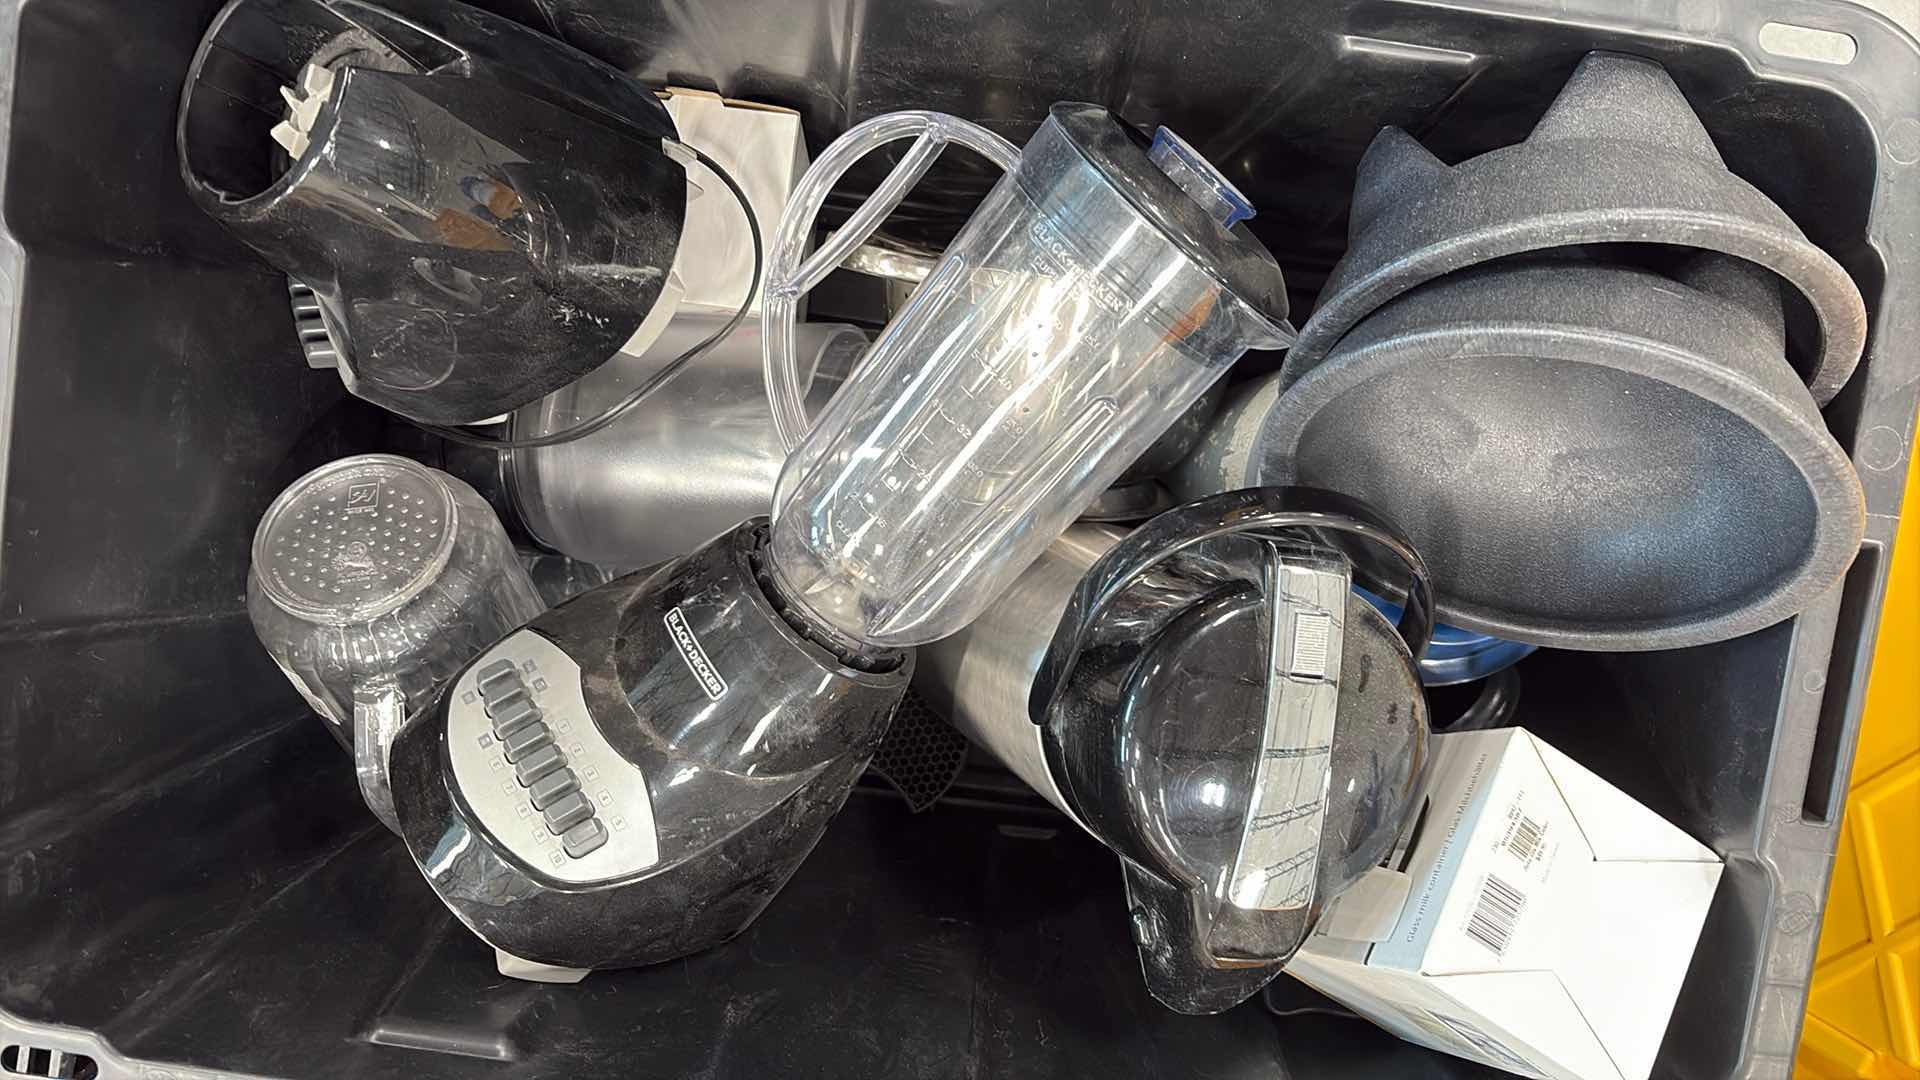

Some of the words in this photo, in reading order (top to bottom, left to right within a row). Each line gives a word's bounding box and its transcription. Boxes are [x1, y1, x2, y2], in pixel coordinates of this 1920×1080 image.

[956, 423, 972, 440] 32
[668, 612, 722, 695] BLACK+DECKER
[1407, 914, 1423, 943] Glass
